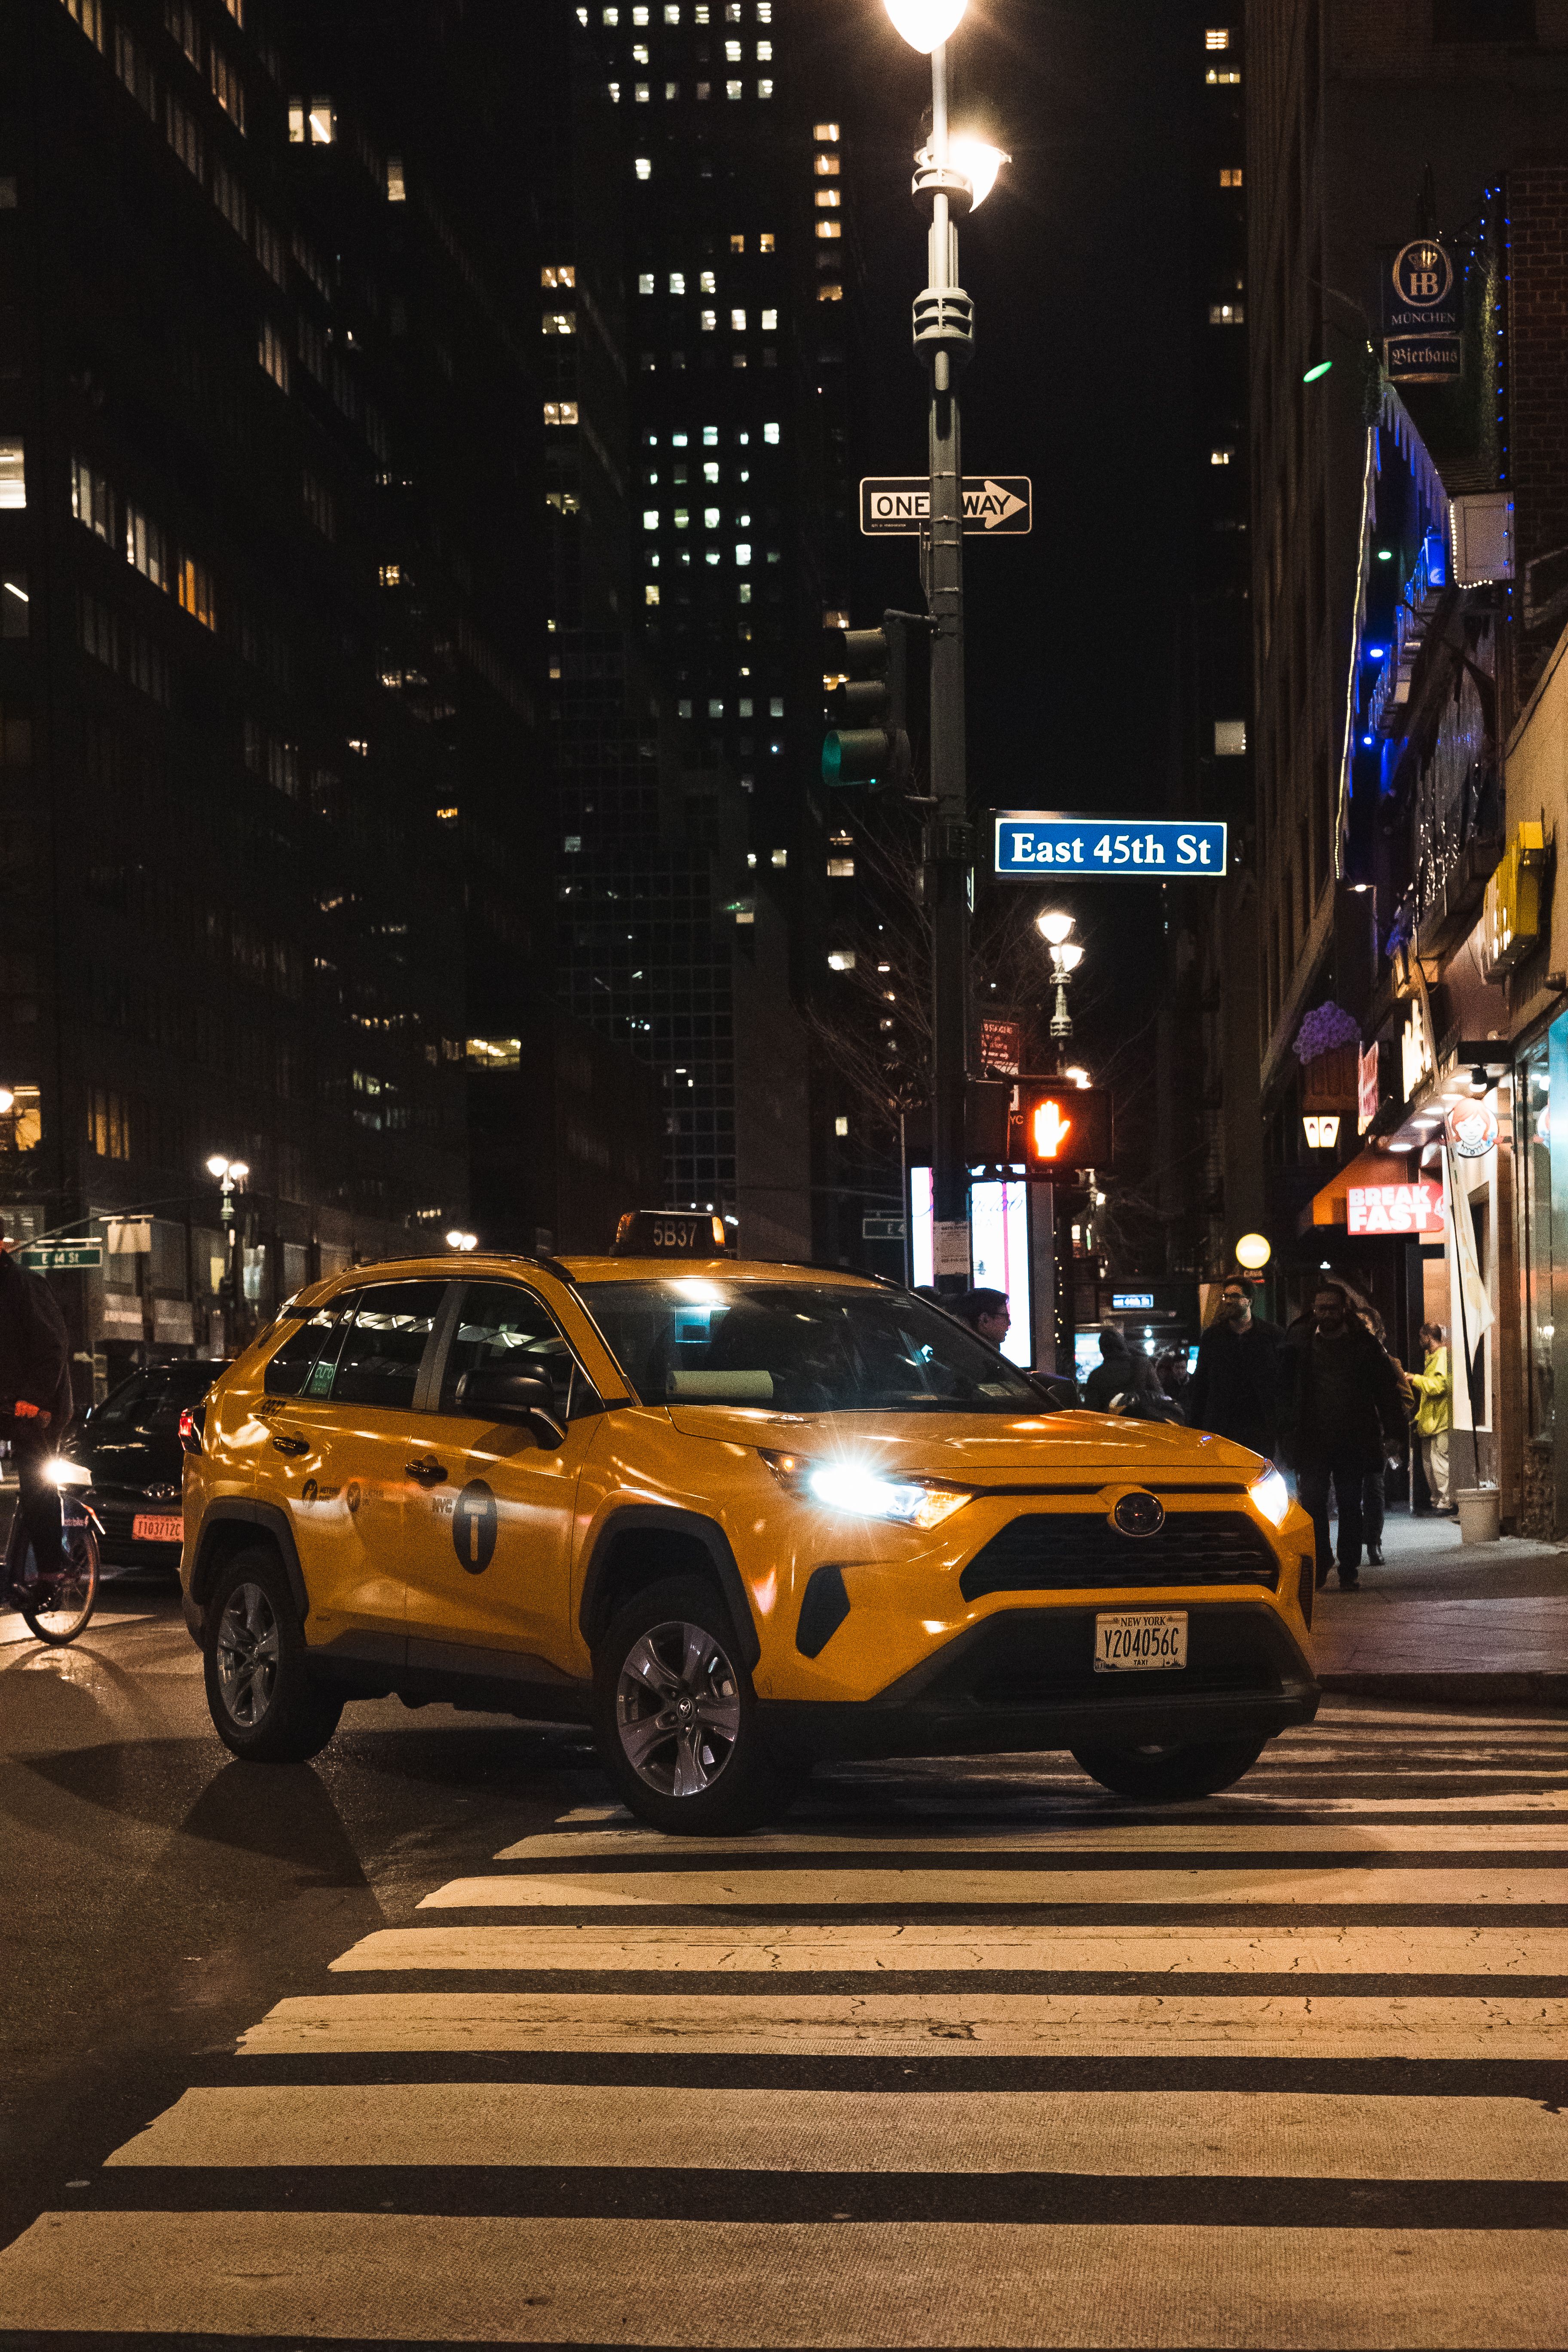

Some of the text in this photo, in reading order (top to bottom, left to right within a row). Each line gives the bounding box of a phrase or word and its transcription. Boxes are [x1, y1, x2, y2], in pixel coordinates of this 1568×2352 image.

[1392, 346, 1458, 365] Bierhaus
[877, 495, 1011, 516] ONE WAY
[1011, 833, 1211, 864] East 45th St
[1349, 1185, 1430, 1206] BREAK
[1349, 1203, 1432, 1231] FAST
[654, 1221, 697, 1247] 5B37
[432, 1498, 488, 1562] NYC T
[1121, 1616, 1167, 1626] NEW YORK
[1104, 1627, 1179, 1658] Y204056C
